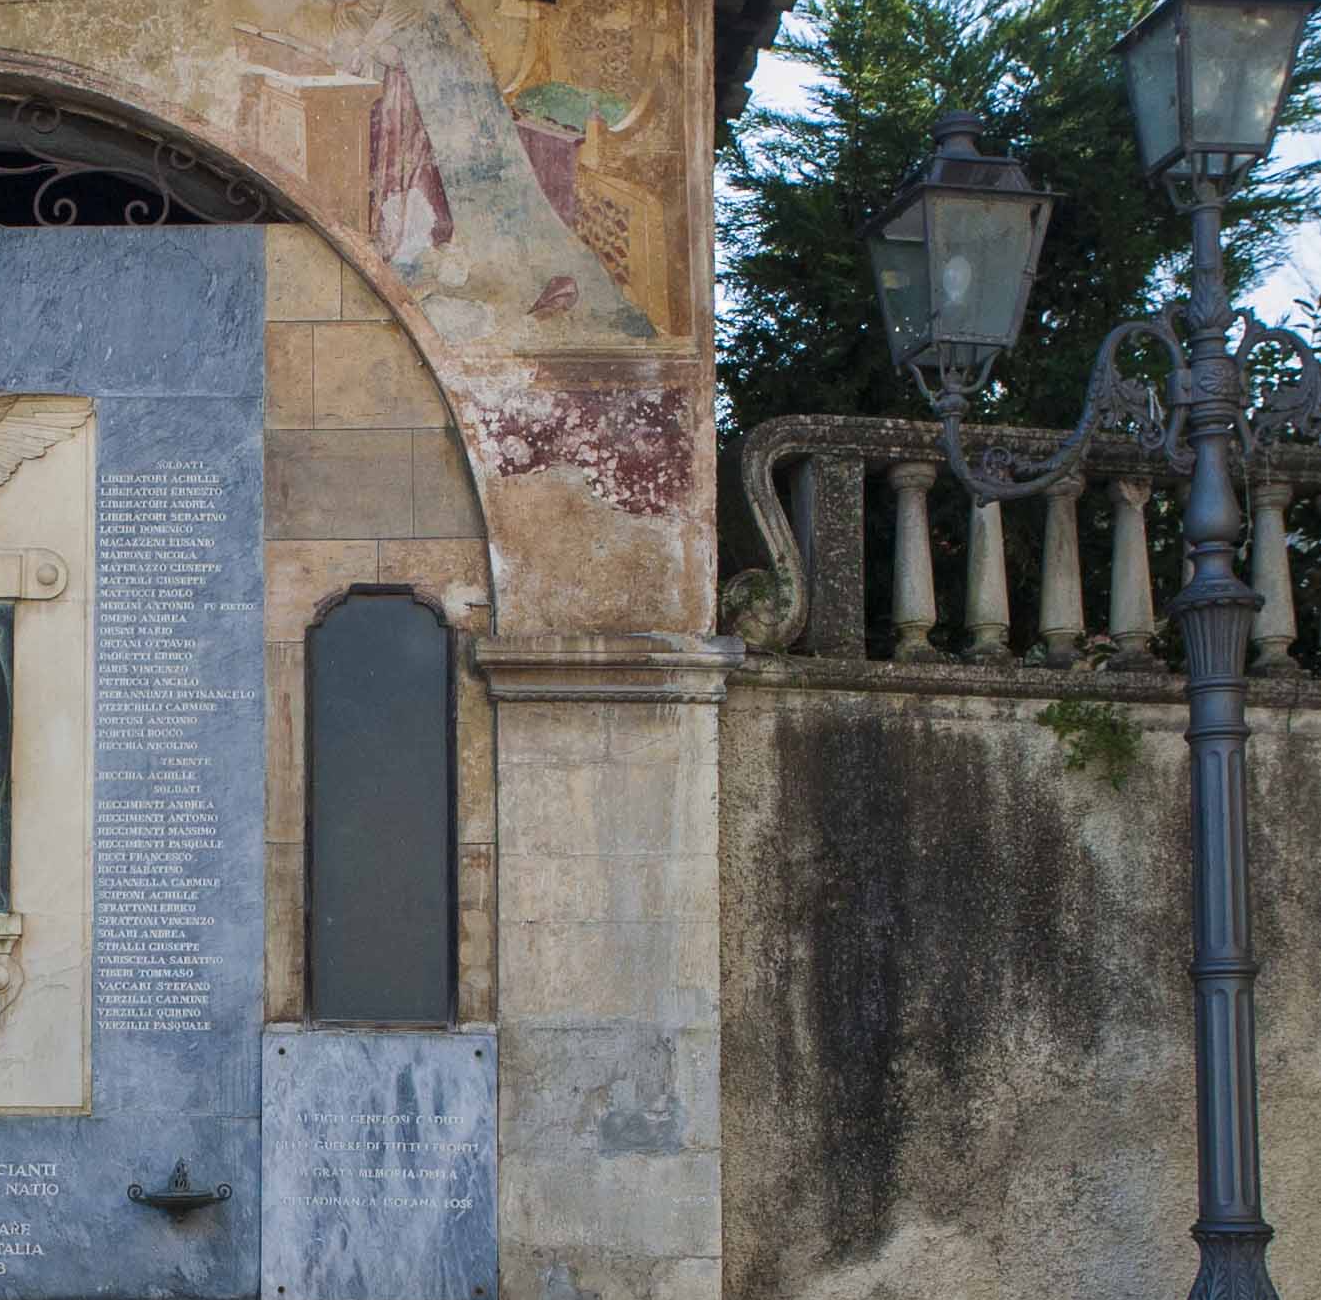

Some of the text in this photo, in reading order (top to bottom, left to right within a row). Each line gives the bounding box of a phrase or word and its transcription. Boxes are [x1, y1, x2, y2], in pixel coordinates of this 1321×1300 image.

[158, 589, 193, 597] PAOLO
[146, 602, 194, 610] ANTONIO
[149, 717, 198, 725] ANTONIO
[161, 917, 214, 925] VINCENZO
[139, 969, 194, 977] TOMMASO
[7, 1183, 59, 1195] NATIO
